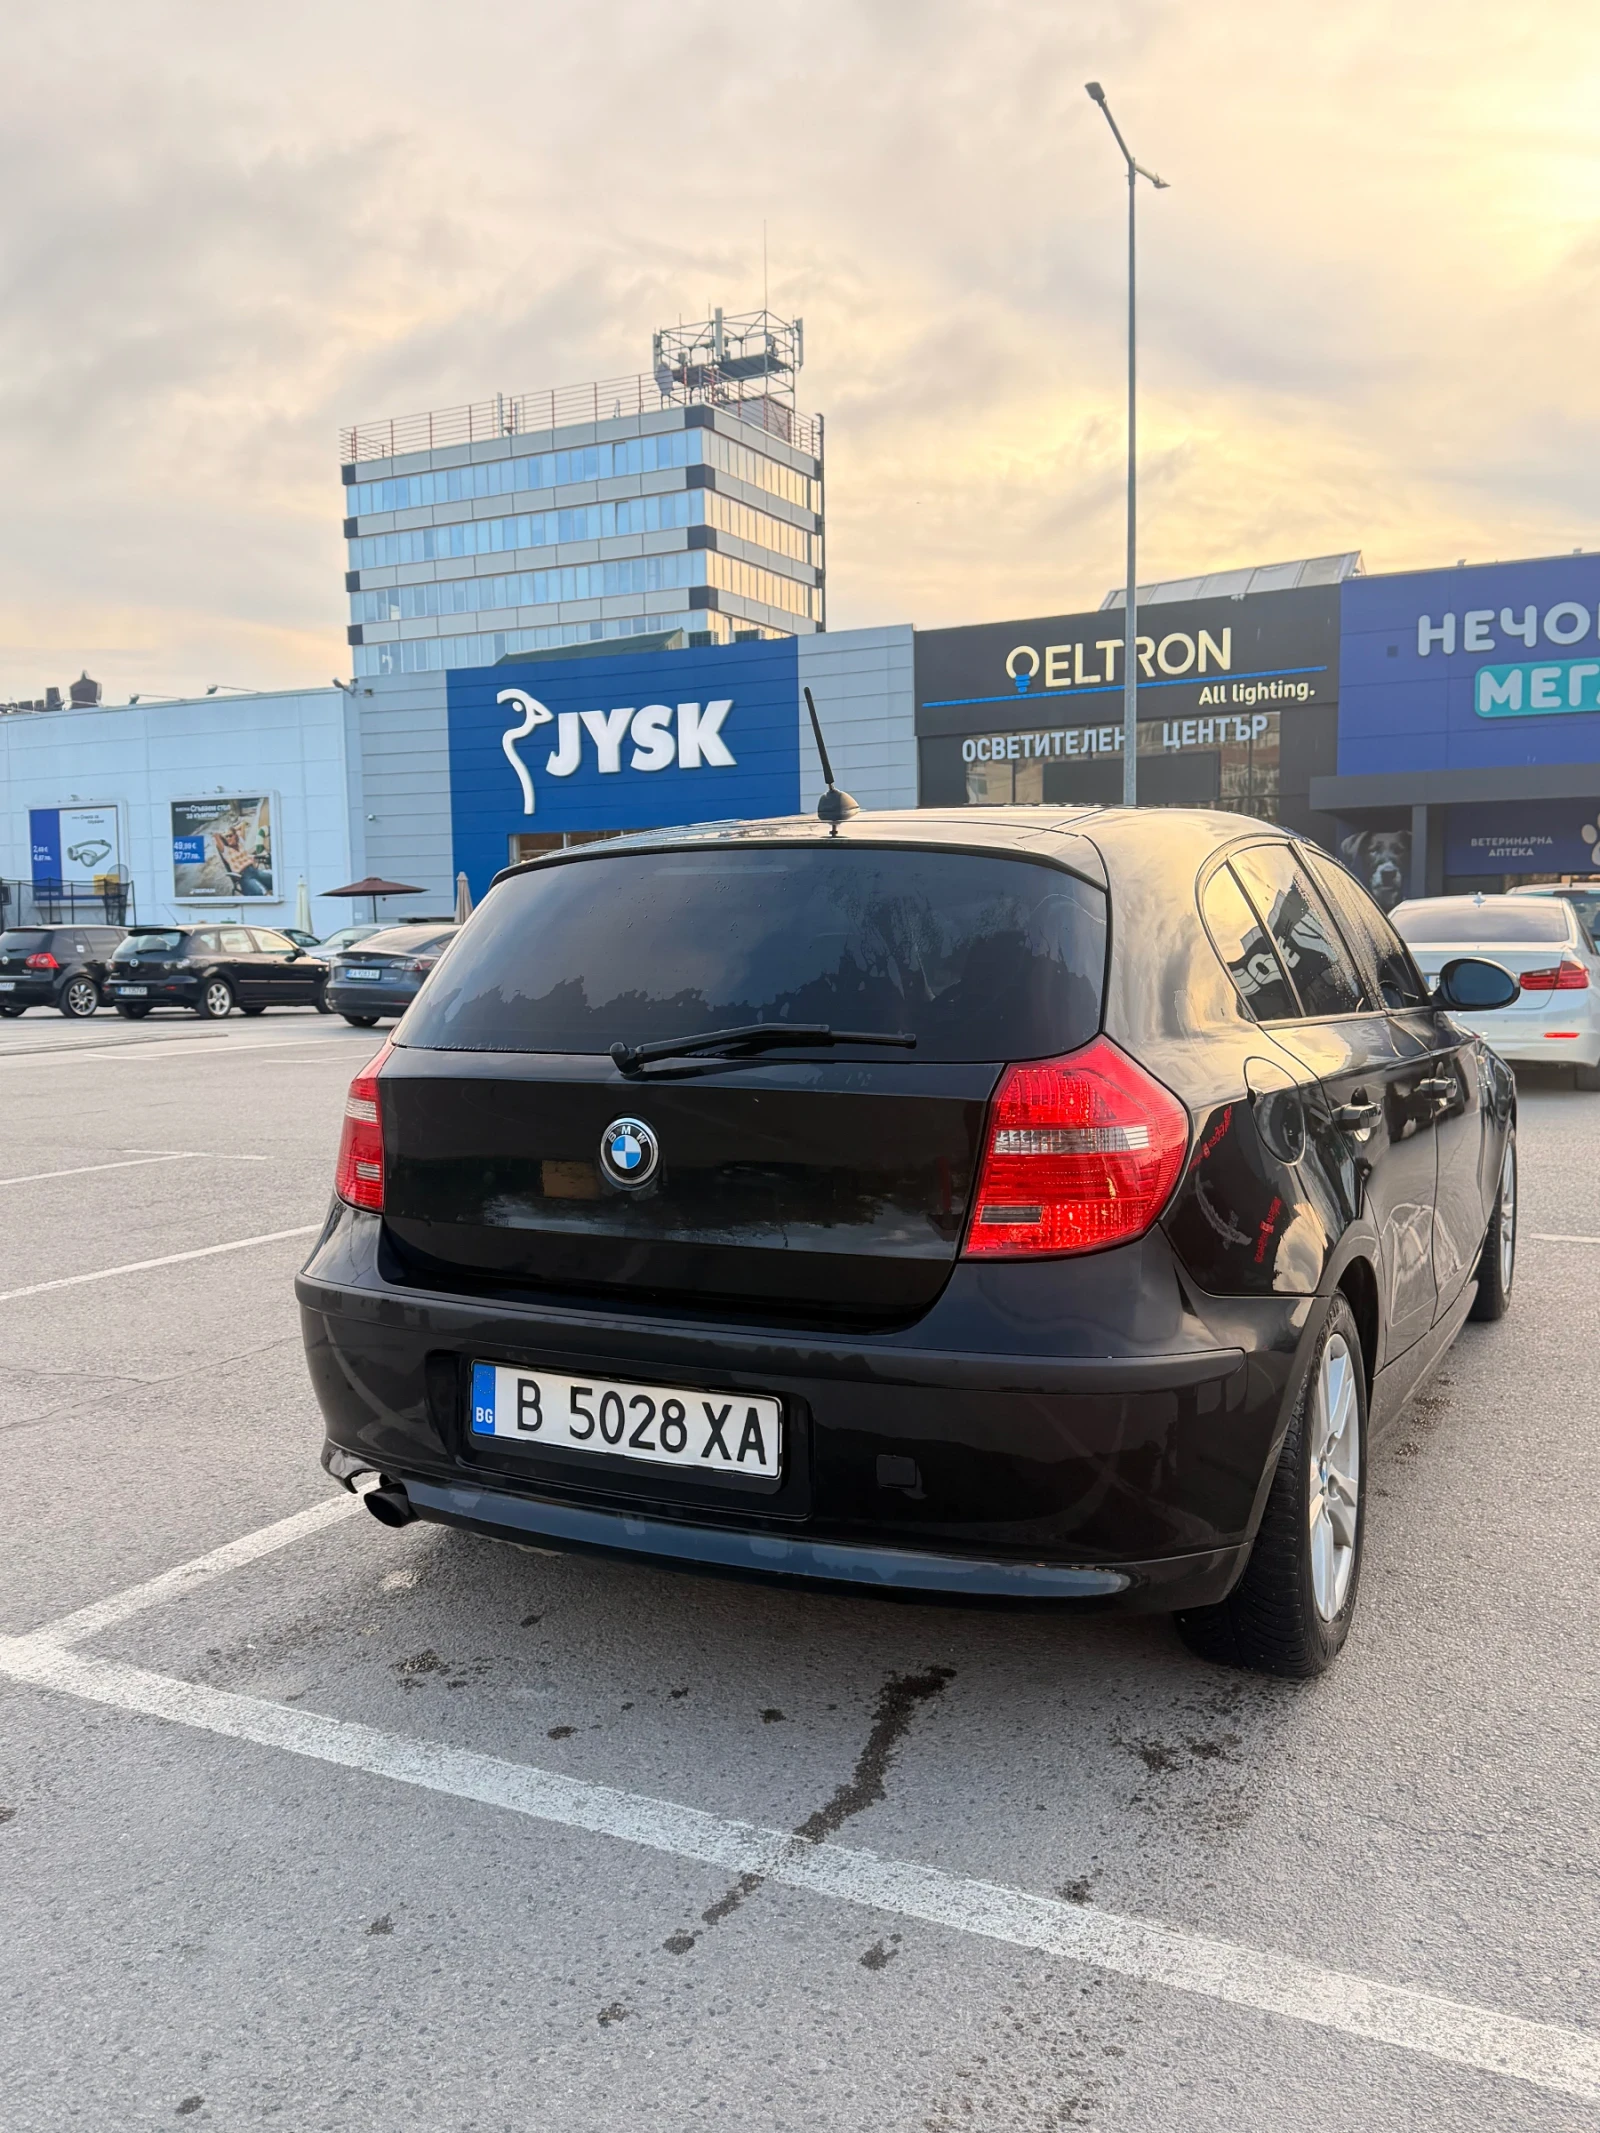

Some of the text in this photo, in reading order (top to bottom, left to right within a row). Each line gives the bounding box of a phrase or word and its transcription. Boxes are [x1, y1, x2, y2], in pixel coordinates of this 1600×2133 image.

[1418, 601, 1600, 656] НЕЧО
[1045, 627, 1232, 687] ELTRON
[1198, 679, 1316, 706] All lighting.
[1479, 664, 1600, 712] МЕГ
[546, 699, 738, 777] JYSK
[1162, 715, 1269, 749] ЦЕНТЪР
[1470, 836, 1553, 847] ВЕТЕРИНАРНА
[1488, 848, 1534, 857] АПТЕКА
[607, 1125, 648, 1145] BMW
[476, 1378, 767, 1465] BG B 5028 XA
